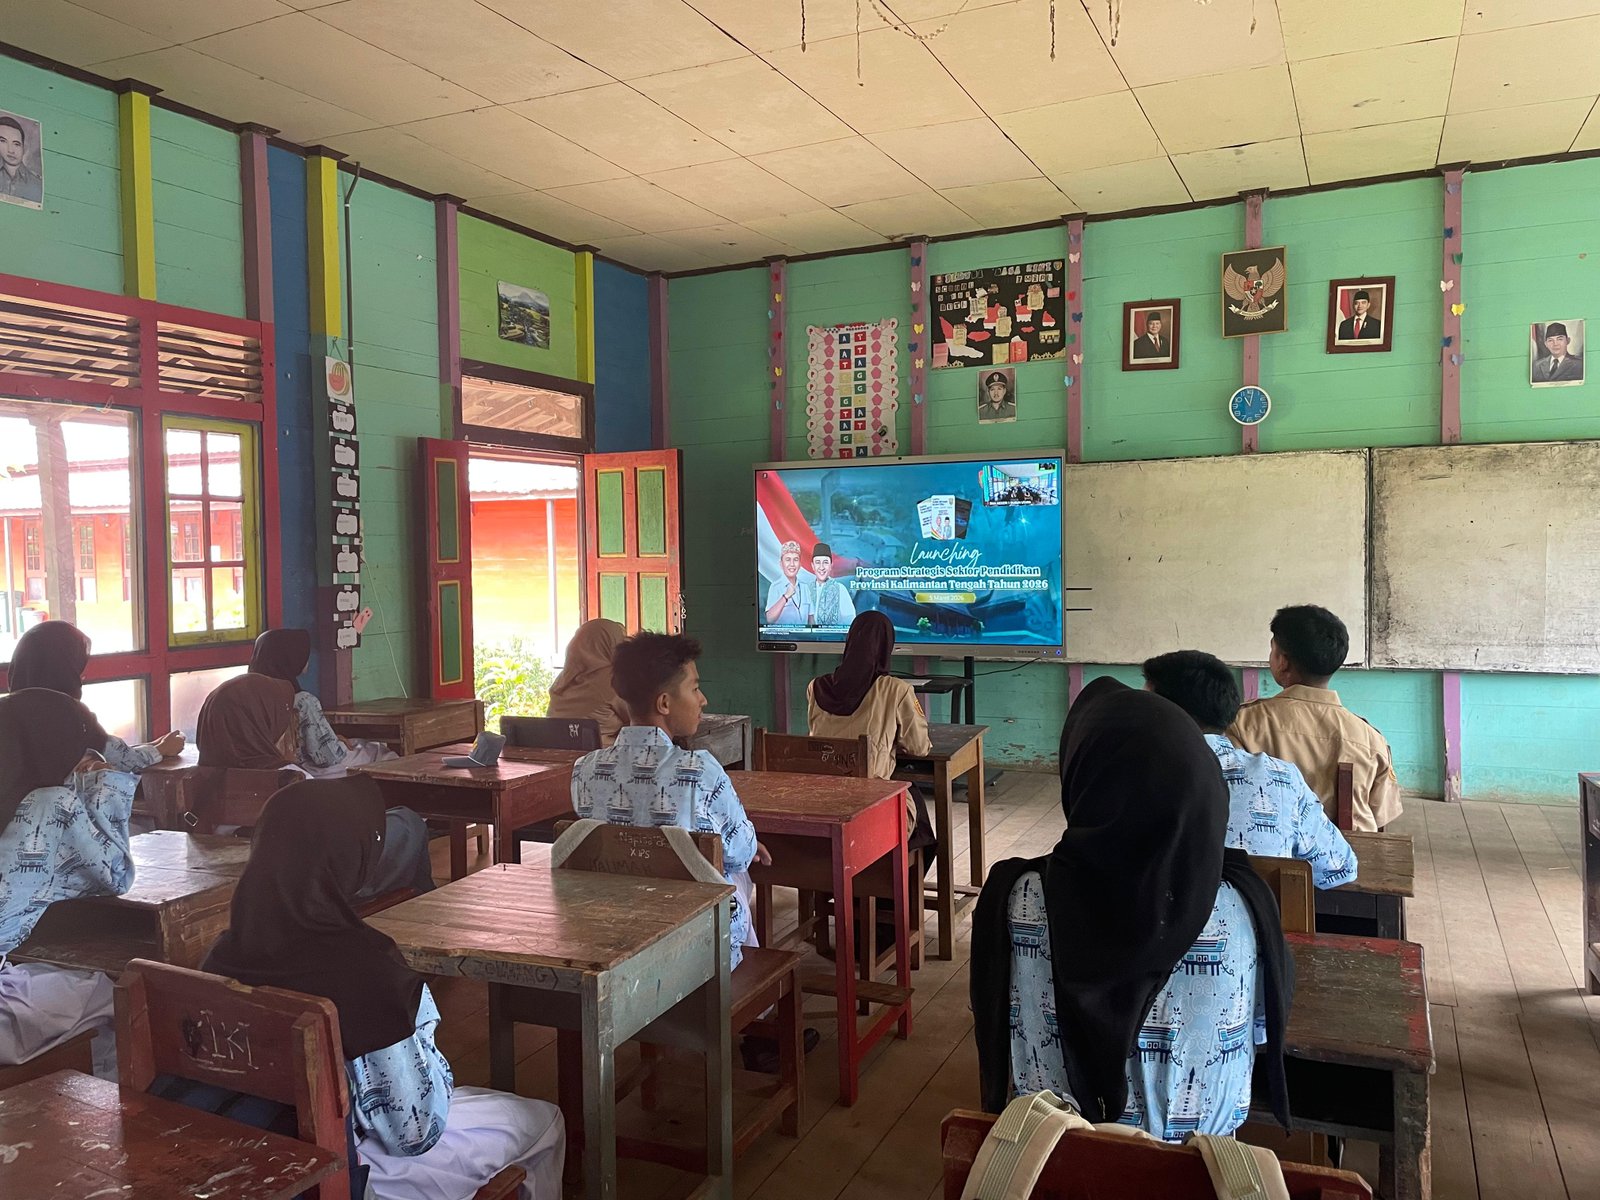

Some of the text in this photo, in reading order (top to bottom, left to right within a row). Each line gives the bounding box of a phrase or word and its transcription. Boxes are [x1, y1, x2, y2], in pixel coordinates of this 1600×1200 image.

[910, 541, 982, 568] Launching
[856, 564, 1041, 579] Program Strategis Sektor Pendidikan
[850, 579, 1049, 591] Provinsi Kalimantan Tengah Tahun 2026
